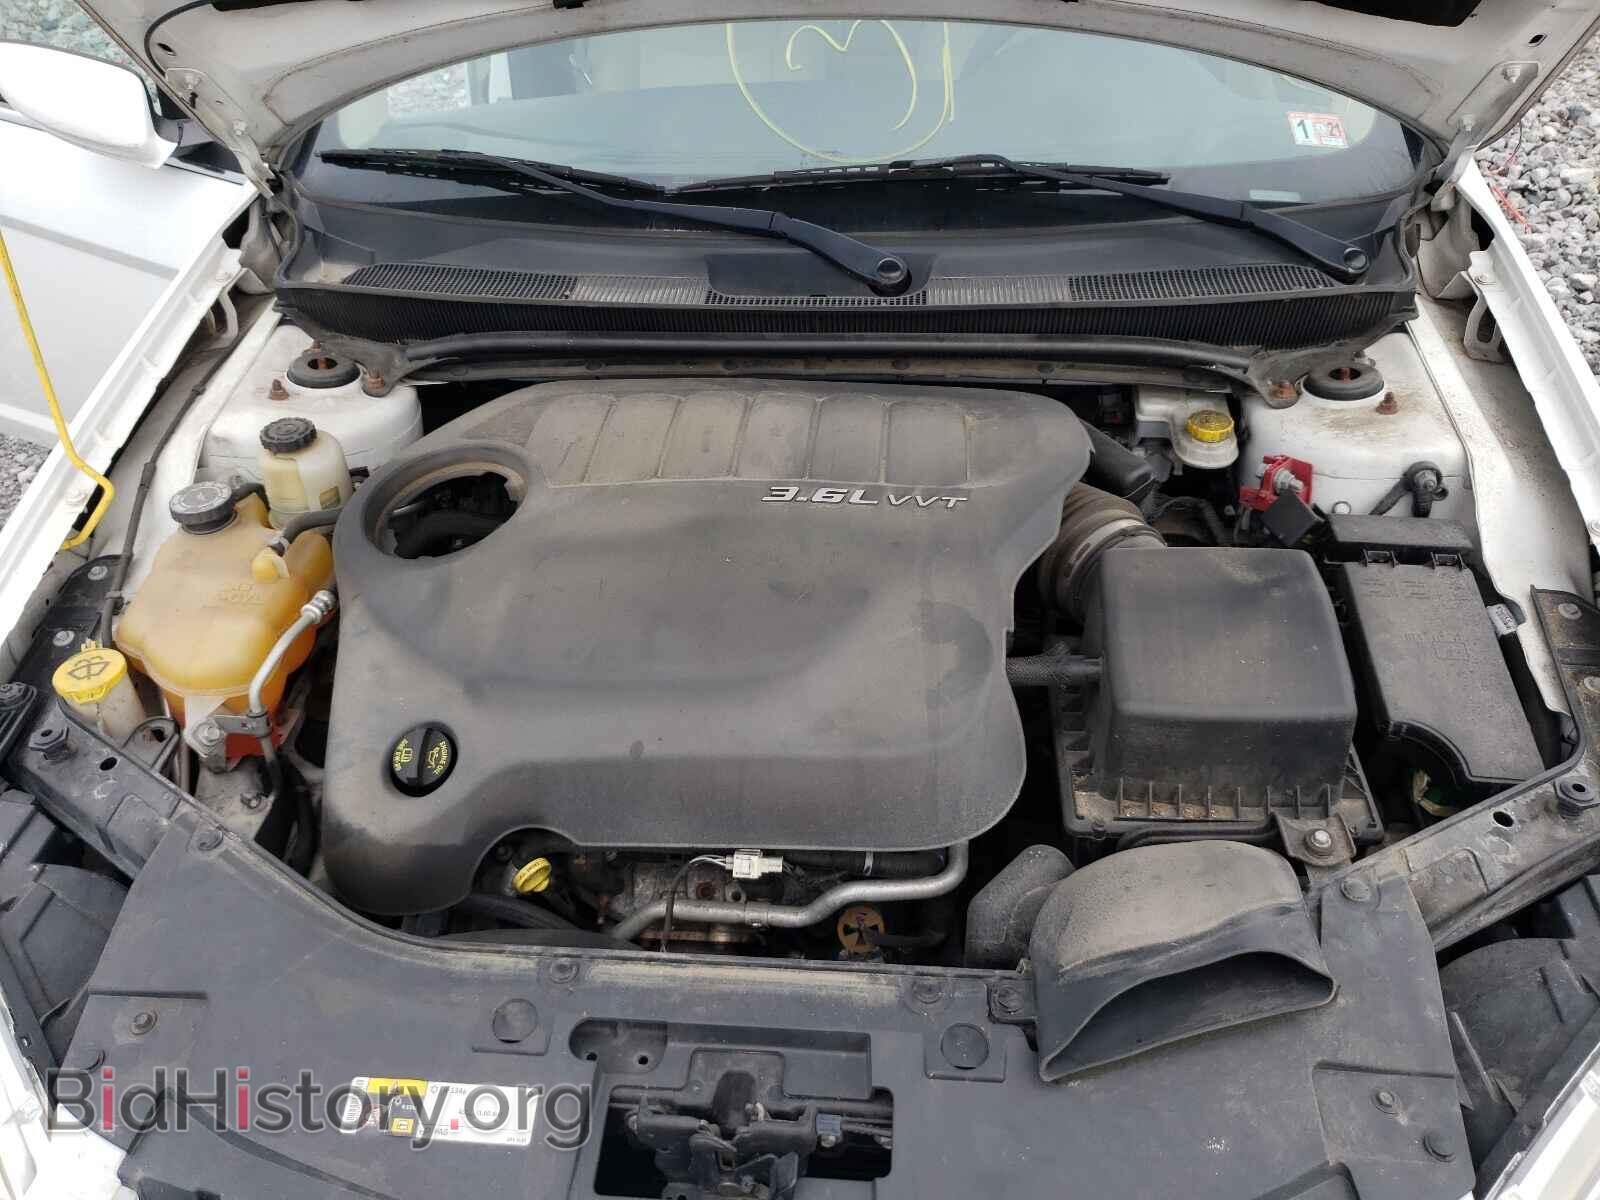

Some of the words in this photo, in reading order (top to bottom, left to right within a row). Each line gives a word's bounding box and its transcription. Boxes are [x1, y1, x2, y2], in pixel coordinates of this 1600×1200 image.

[761, 486, 879, 504] 3.6L
[887, 494, 968, 508] VVT
[439, 740, 449, 765] ENGINE
